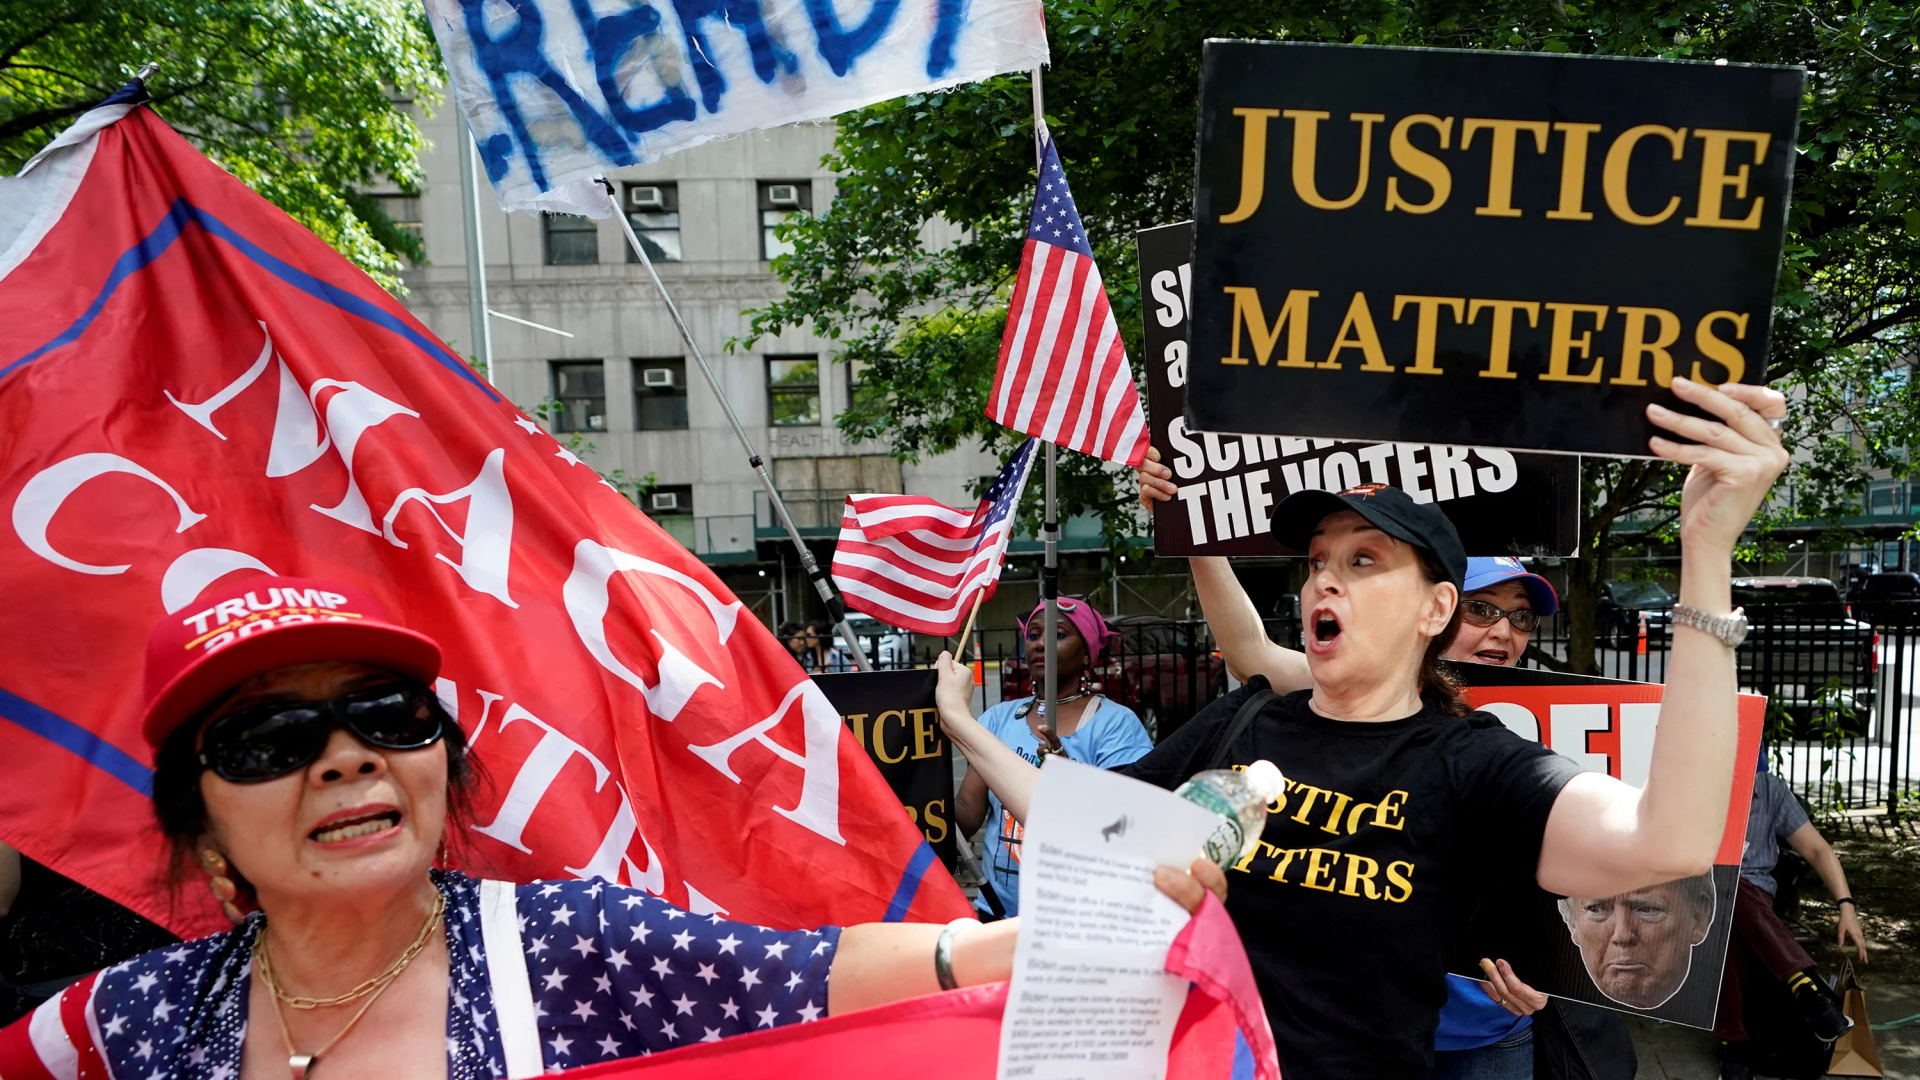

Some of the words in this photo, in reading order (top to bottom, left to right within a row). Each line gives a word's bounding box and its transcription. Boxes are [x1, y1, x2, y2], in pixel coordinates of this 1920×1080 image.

[1219, 107, 1771, 230] JUSTICE
[1220, 286, 1750, 389] MATTERS
[768, 433, 832, 447] HEALTH
[1178, 469, 1275, 547] THE
[182, 587, 348, 636] TRUMP
